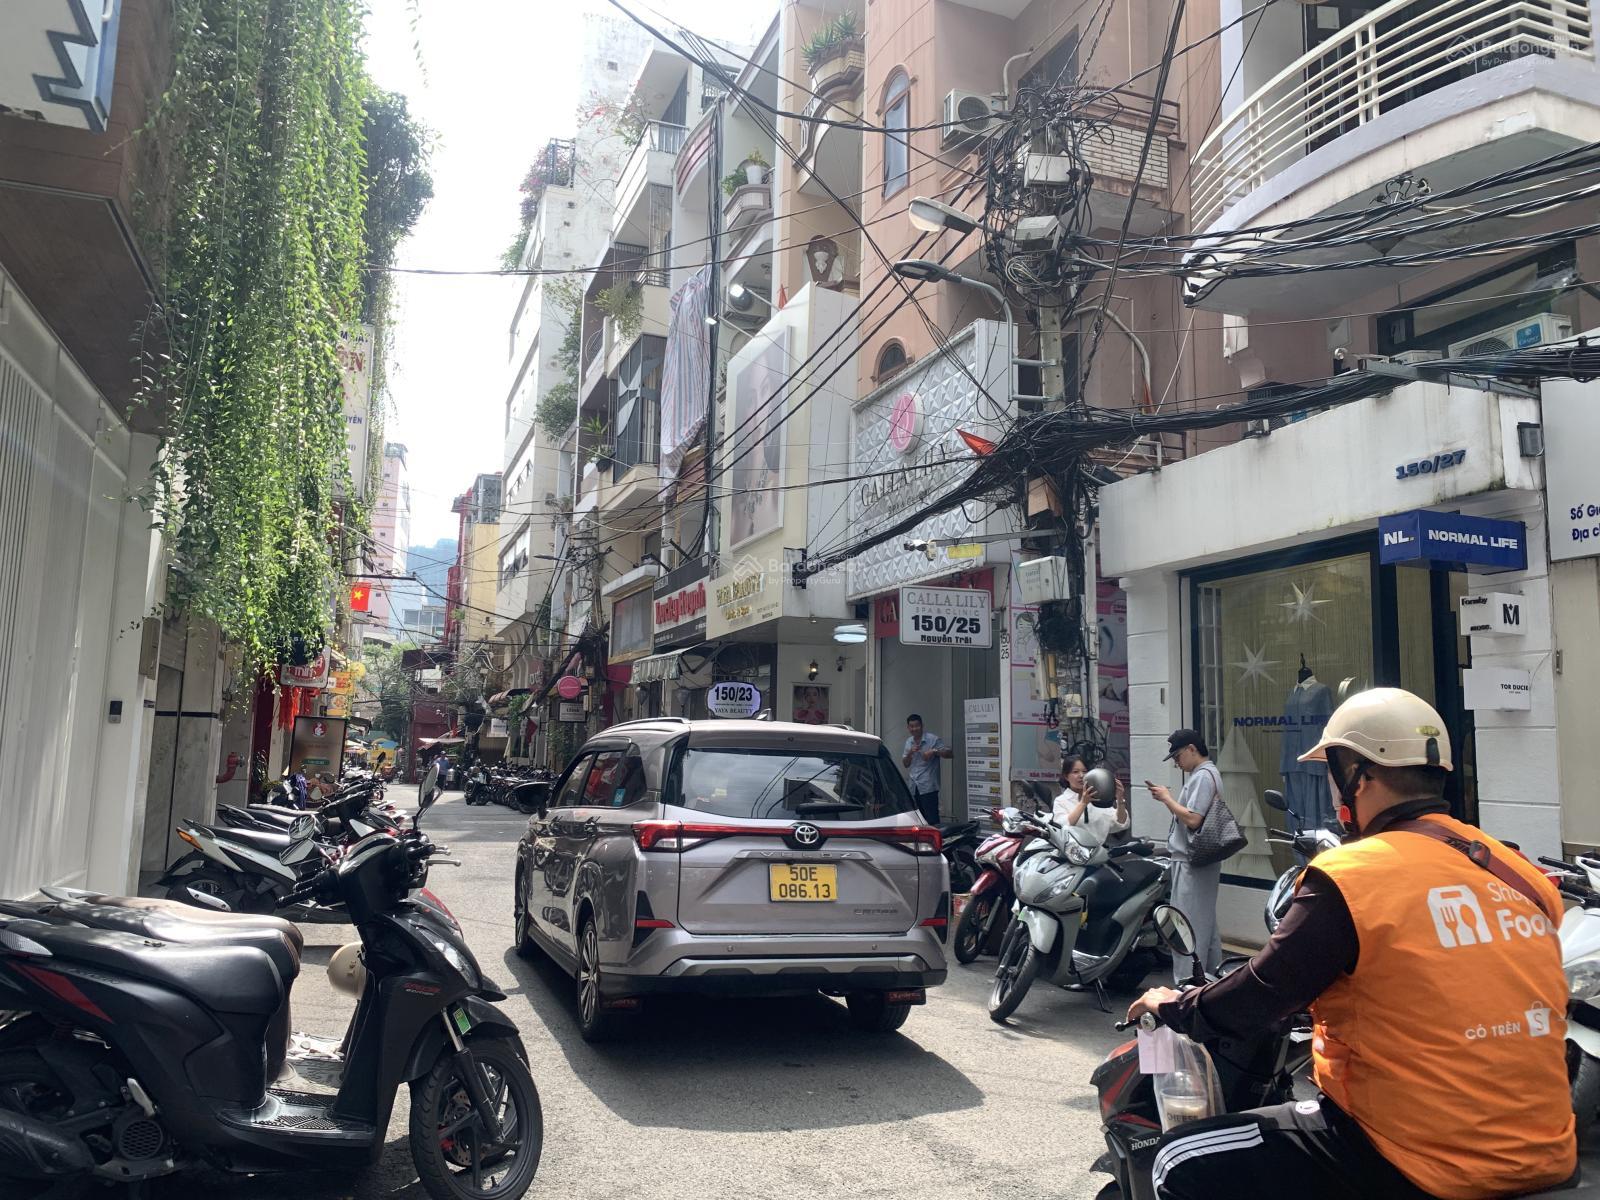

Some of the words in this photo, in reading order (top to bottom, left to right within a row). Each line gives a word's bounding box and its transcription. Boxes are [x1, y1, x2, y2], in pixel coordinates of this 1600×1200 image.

[1395, 449, 1467, 480] 150/27
[1570, 503, 1585, 520] Số
[1428, 530, 1488, 546] NORMAL
[1490, 536, 1518, 550] LIFE
[1572, 528, 1590, 543] Địa
[907, 592, 952, 607] CALLA
[956, 594, 987, 609] LILY
[916, 606, 934, 614] SPA
[945, 608, 980, 616] CLINIC
[911, 615, 981, 635] 150/25
[1000, 648, 1009, 660] 25
[714, 686, 753, 702] 150/23
[1233, 715, 1298, 728] NORMAL
[789, 866, 818, 881] 50E
[778, 883, 831, 898] 086.13
[1465, 1023, 1487, 1040] CÓ
[1491, 1021, 1521, 1037] TRÊN
